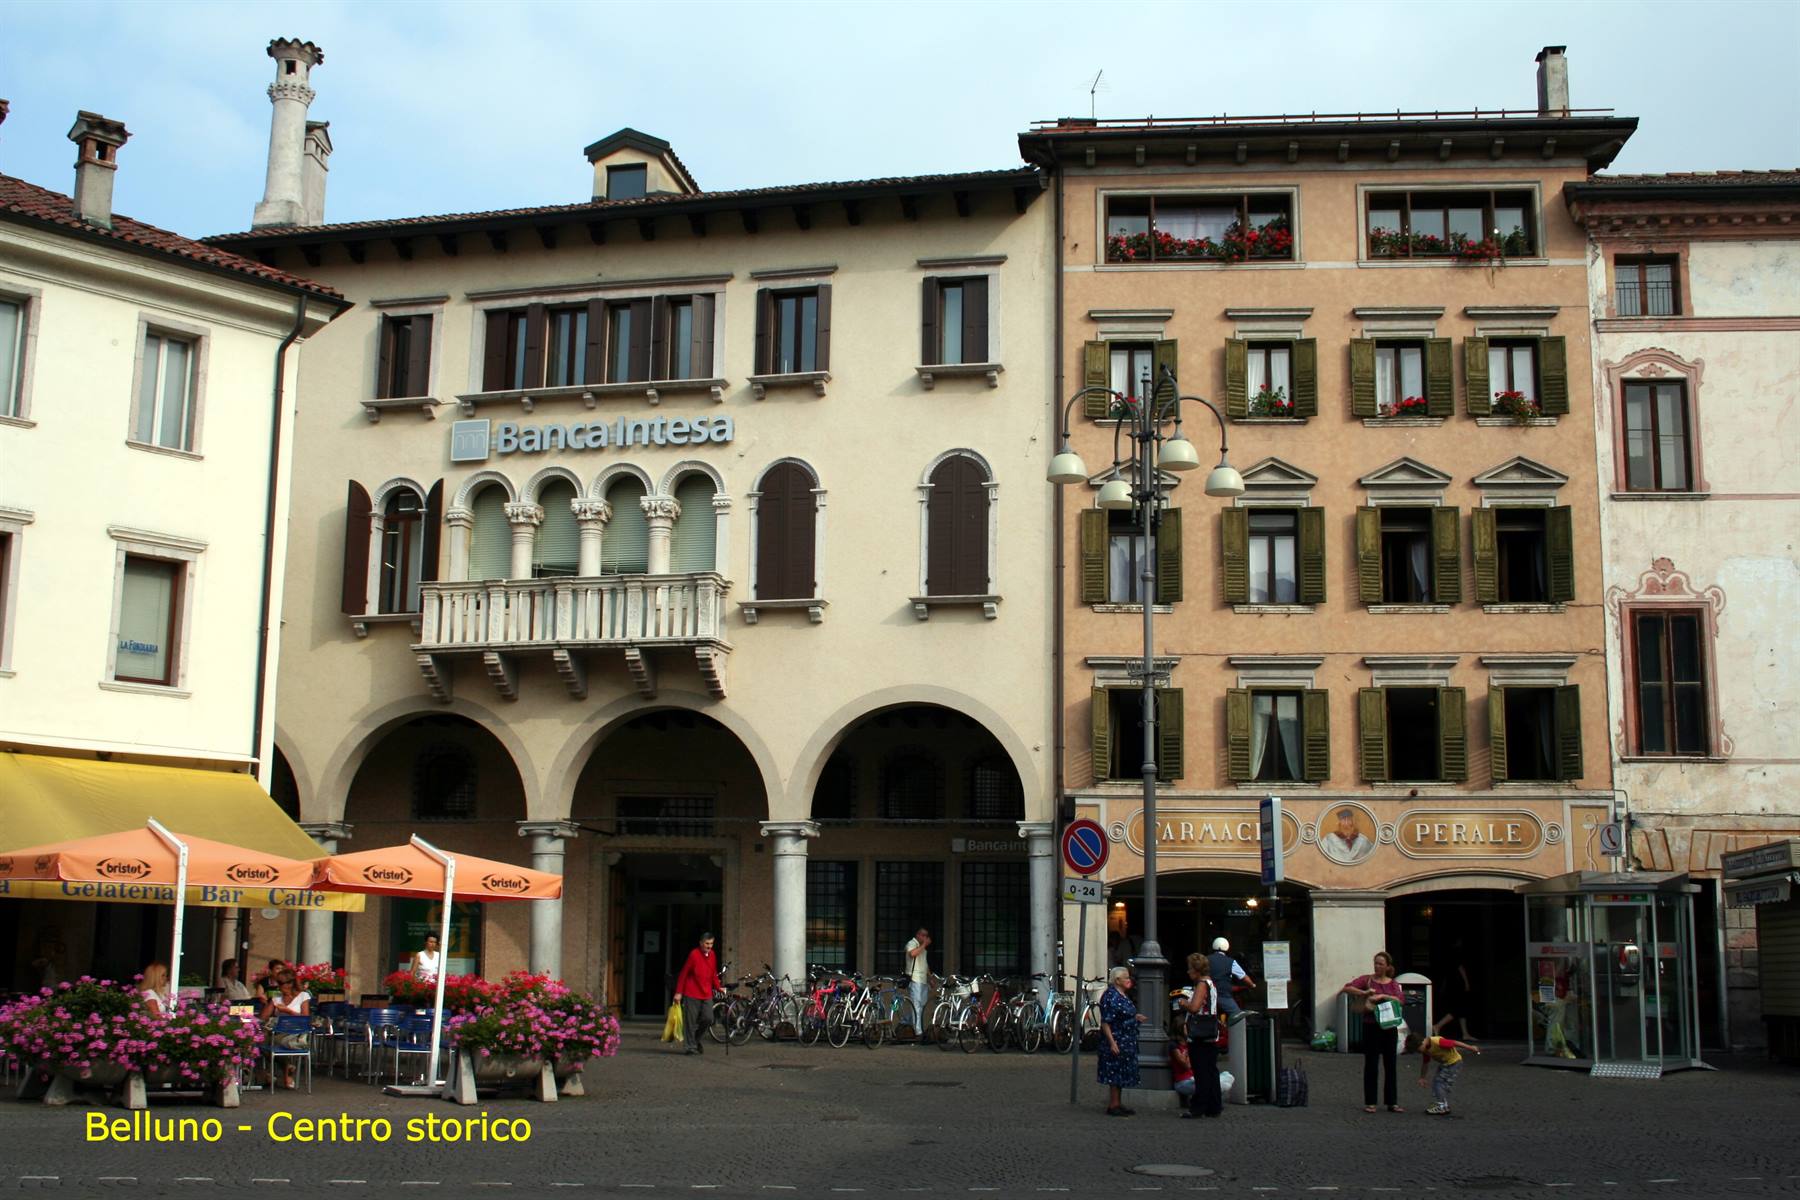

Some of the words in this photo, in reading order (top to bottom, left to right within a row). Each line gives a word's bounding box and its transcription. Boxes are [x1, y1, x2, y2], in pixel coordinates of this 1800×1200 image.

[497, 420, 608, 453] Banca
[615, 414, 734, 447] Intesa
[1155, 821, 1261, 844] ARMACI
[1415, 823, 1521, 843] PERALE
[967, 840, 1008, 851] Banca
[106, 863, 142, 874] bristot
[236, 868, 270, 880] bristot
[372, 869, 404, 880] bristot
[490, 878, 522, 889] bristot
[62, 880, 174, 900] Gelateria
[201, 885, 243, 903] Bar
